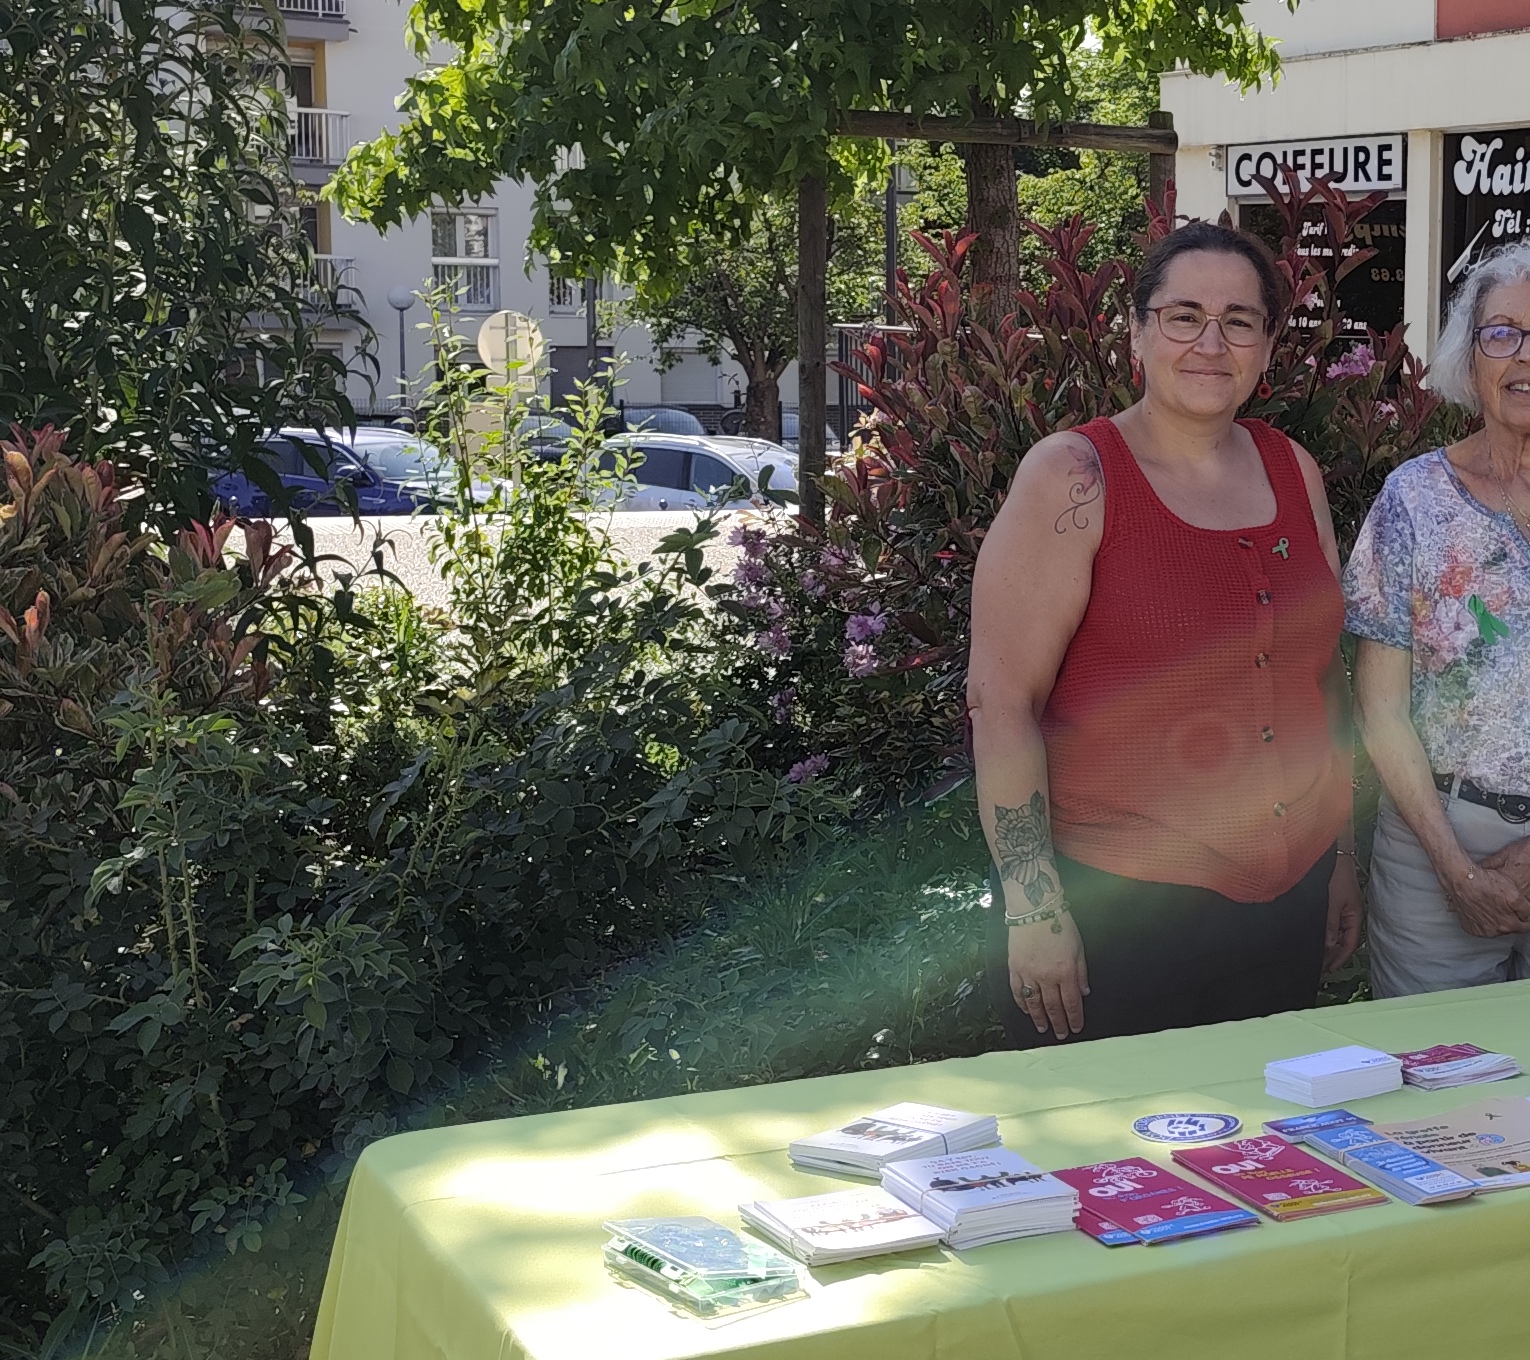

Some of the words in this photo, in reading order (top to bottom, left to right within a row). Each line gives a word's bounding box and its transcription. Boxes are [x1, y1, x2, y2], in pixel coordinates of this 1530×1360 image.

[1235, 144, 1393, 188] COIFFURE
[1301, 222, 1324, 237] Tarif
[1492, 209, 1521, 238] Tél
[1298, 316, 1307, 328] 10
[1353, 321, 1367, 330] ans
[1211, 1160, 1265, 1174] OUI
[1088, 1178, 1145, 1197] OUI
